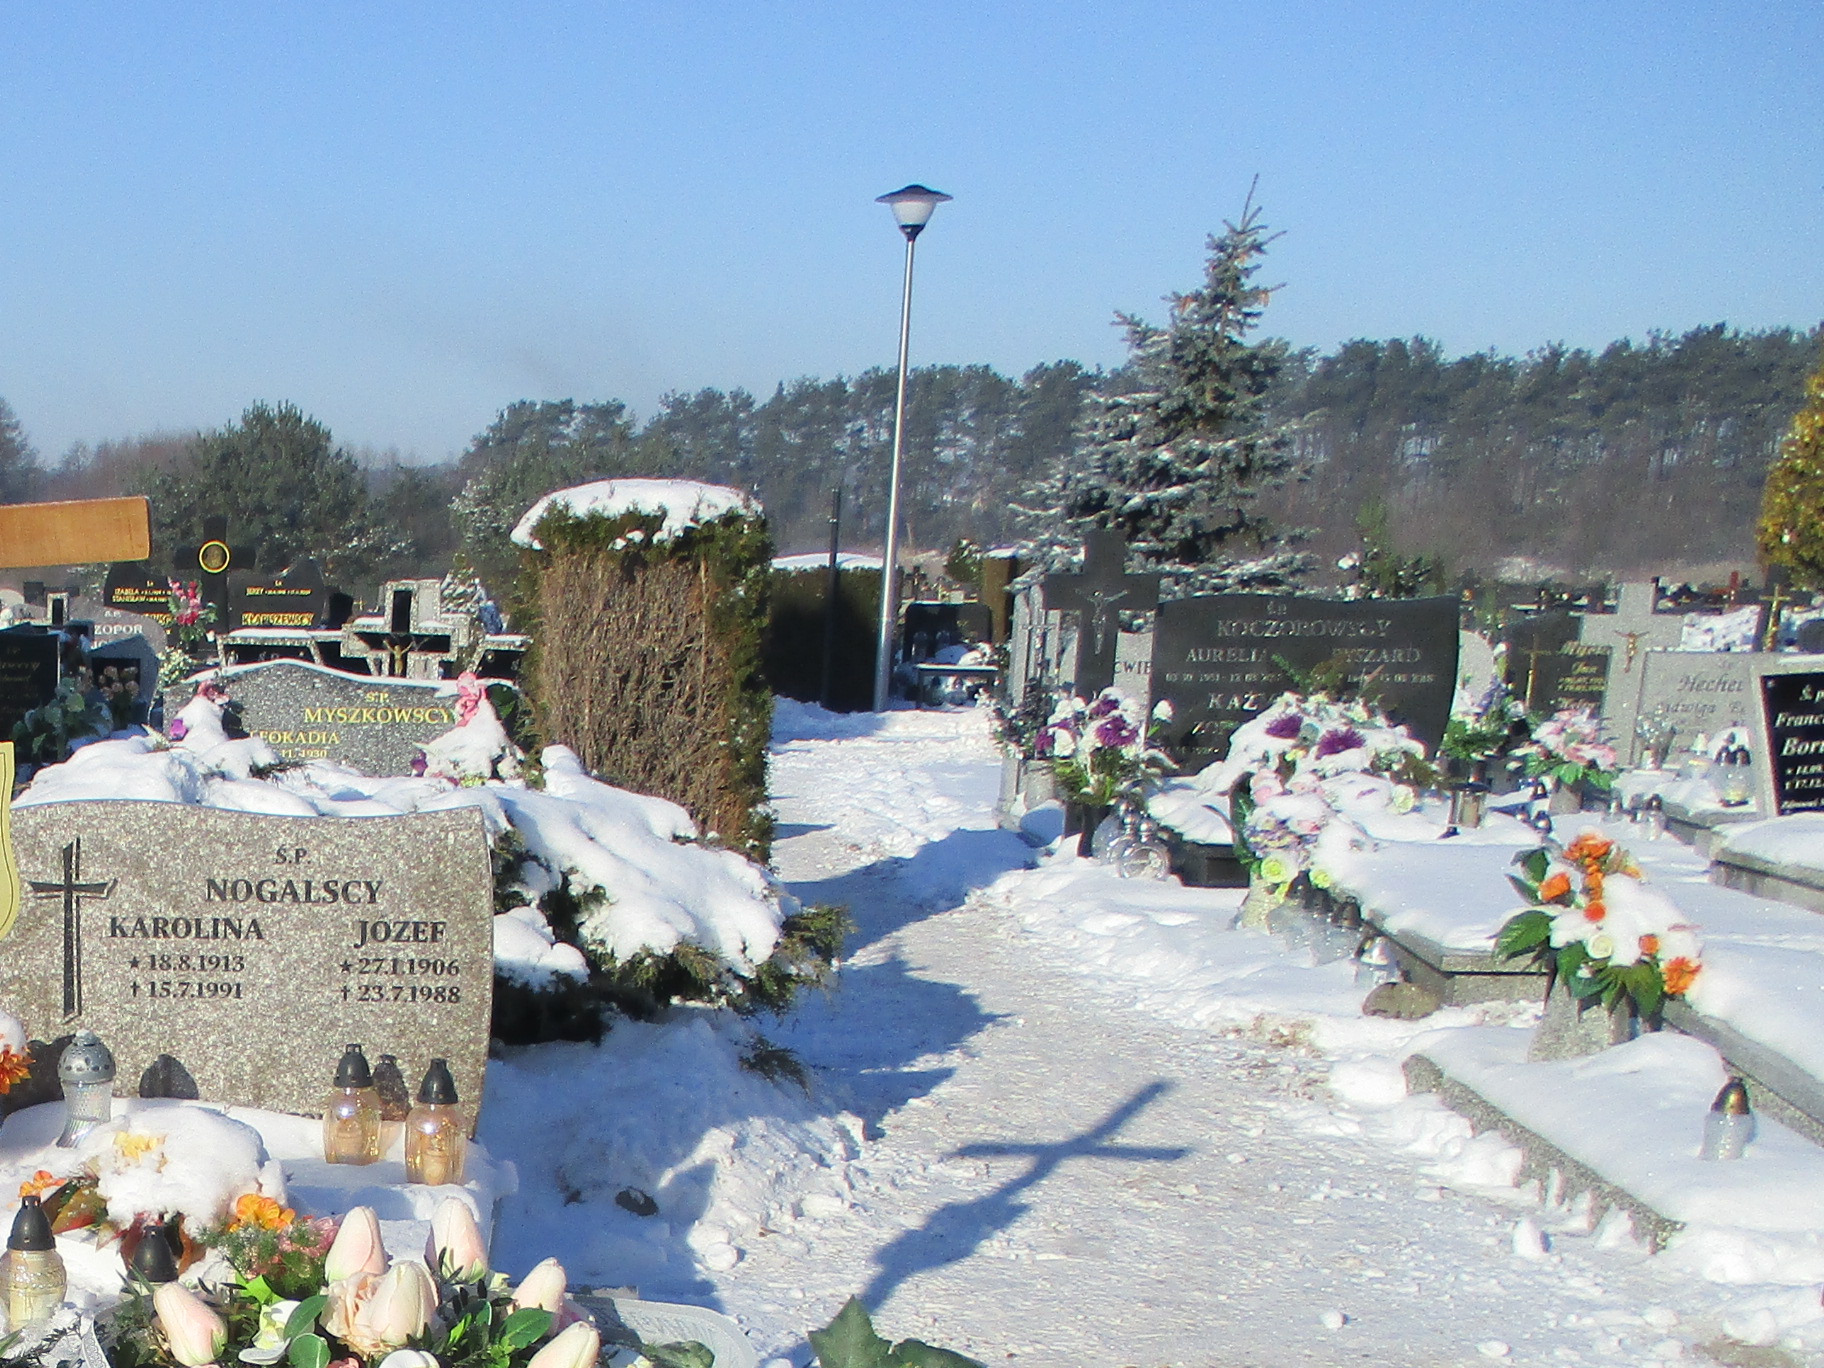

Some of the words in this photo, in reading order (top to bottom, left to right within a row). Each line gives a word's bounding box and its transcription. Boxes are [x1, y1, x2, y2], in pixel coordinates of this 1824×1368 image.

[1217, 619, 1392, 638] KOCZOROWSCY
[304, 707, 456, 725] MYSZKOWSCY
[205, 878, 384, 905] NOGALSCY
[109, 915, 265, 941] KAROLINA
[149, 954, 246, 973] 18.8.1913
[357, 957, 462, 977] 27.1.1906
[149, 981, 244, 1000] 15.7.1991
[357, 985, 462, 1004] 23.7.1988
